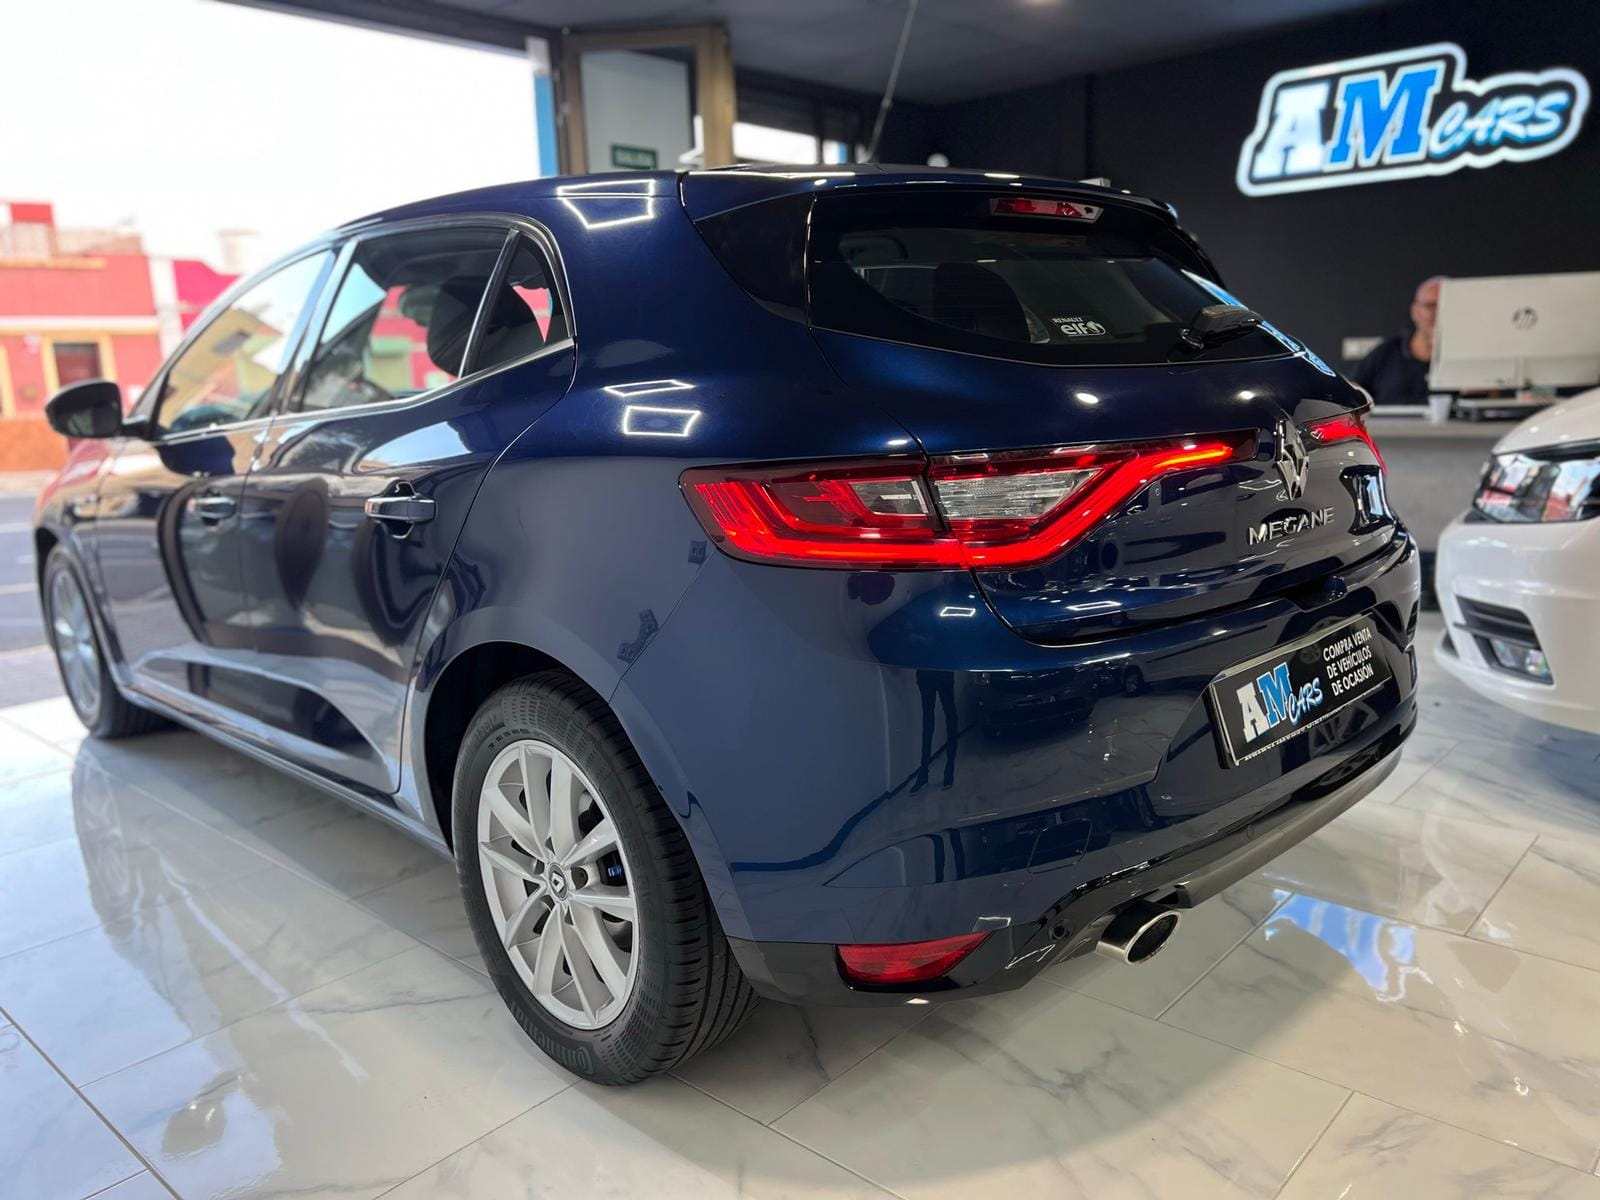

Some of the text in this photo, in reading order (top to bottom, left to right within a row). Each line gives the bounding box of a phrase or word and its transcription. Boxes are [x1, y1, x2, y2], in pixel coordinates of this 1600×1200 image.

[1252, 60, 1570, 180] AM CARS
[1060, 322, 1089, 336] elf
[1247, 507, 1336, 546] MEGANE
[1323, 627, 1372, 662] COMPRA VENTA
[1326, 645, 1372, 679] DE VEHÍCULOS
[1331, 662, 1374, 696] DE OCASIÓN
[1236, 661, 1293, 744] AM
[1288, 677, 1324, 726] CARS
